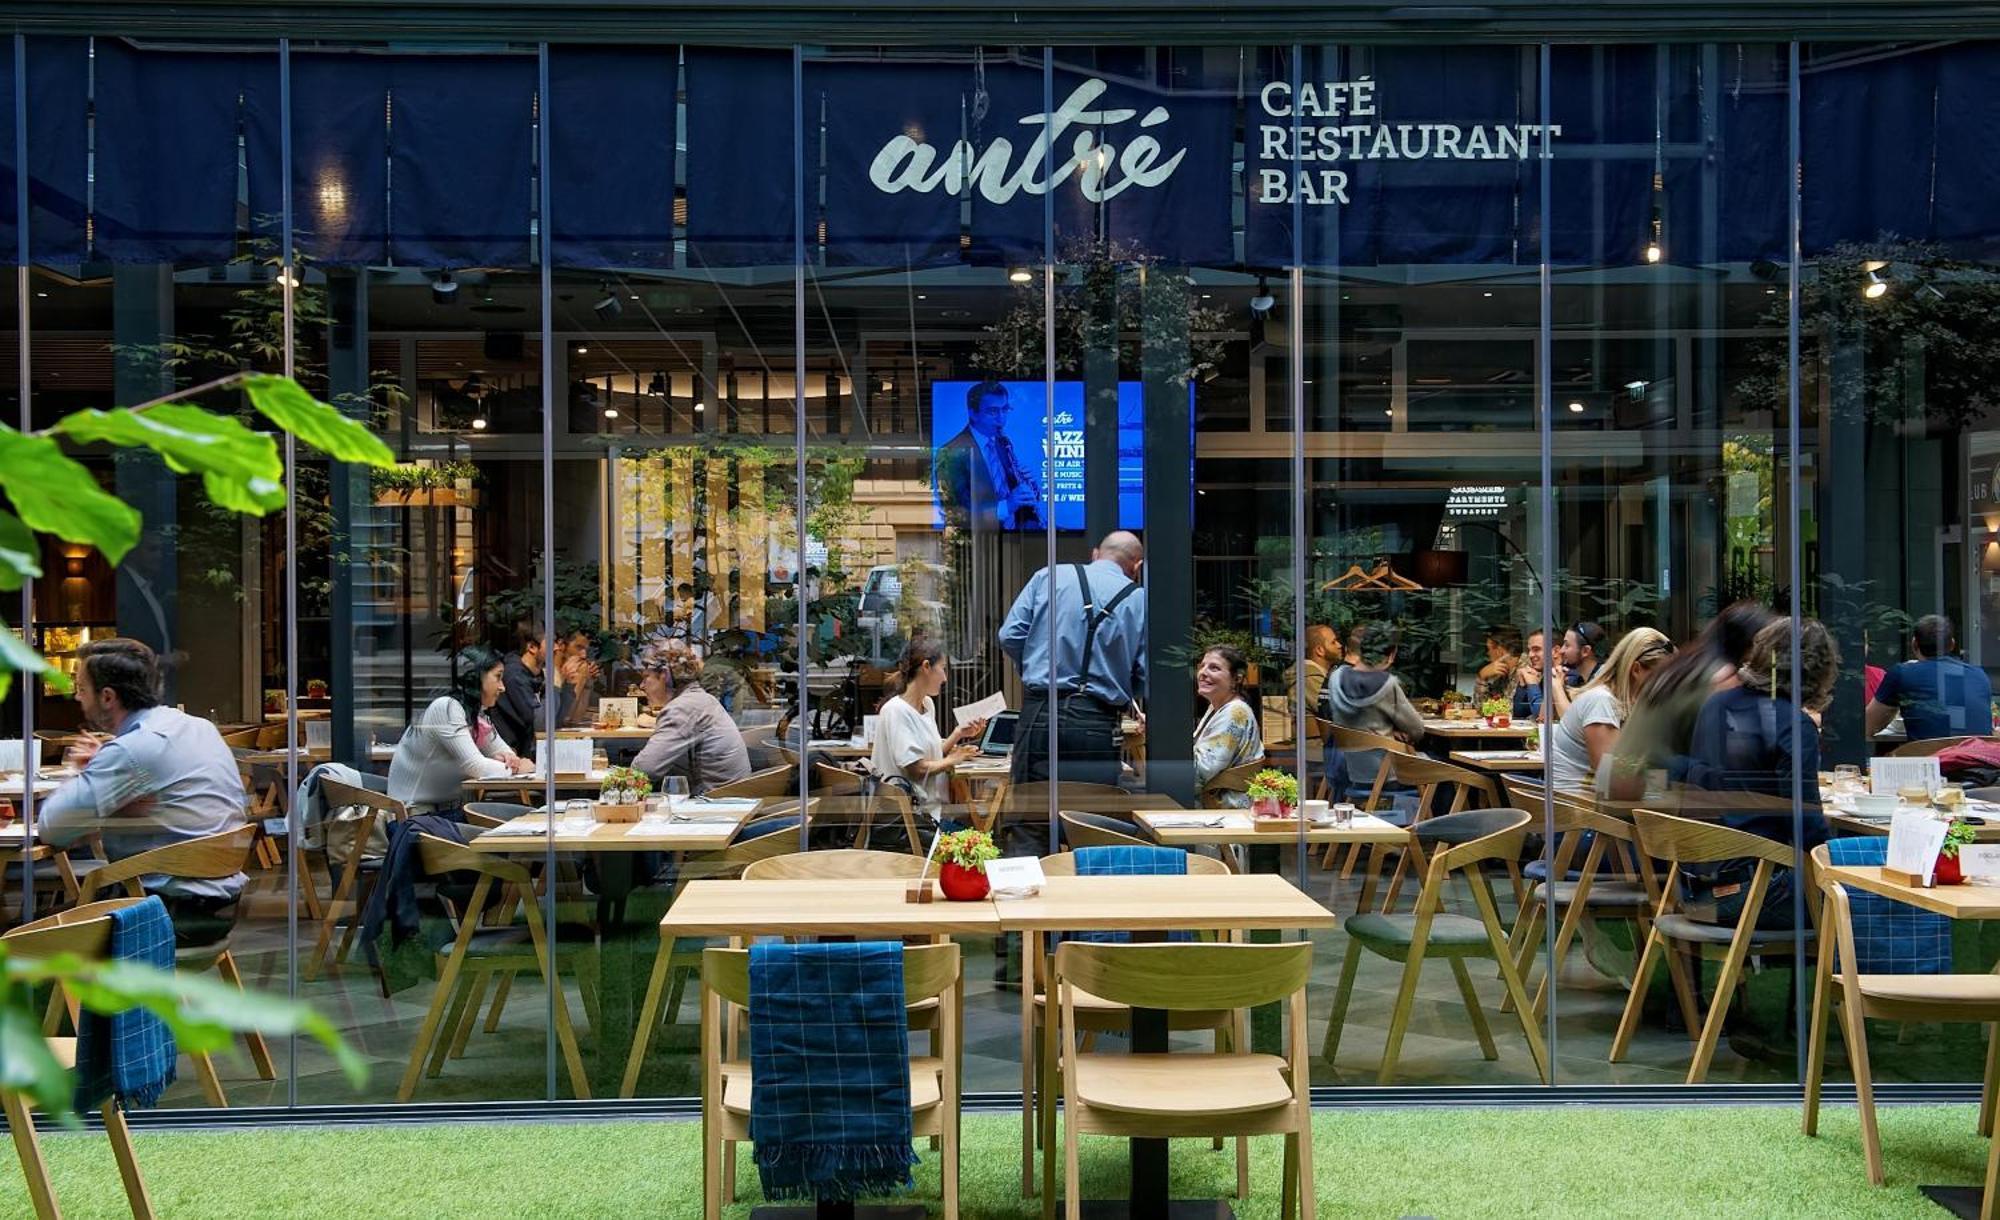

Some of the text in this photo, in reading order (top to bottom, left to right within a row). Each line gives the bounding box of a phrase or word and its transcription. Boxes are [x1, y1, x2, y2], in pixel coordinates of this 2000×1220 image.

[1260, 76, 1376, 117] CAFÉ
[869, 78, 1187, 204] antré
[1259, 124, 1562, 160] RESTAURANT
[1259, 168, 1350, 204] BAR
[1042, 460, 1065, 468] OEN
[1042, 494, 1060, 502] TE
